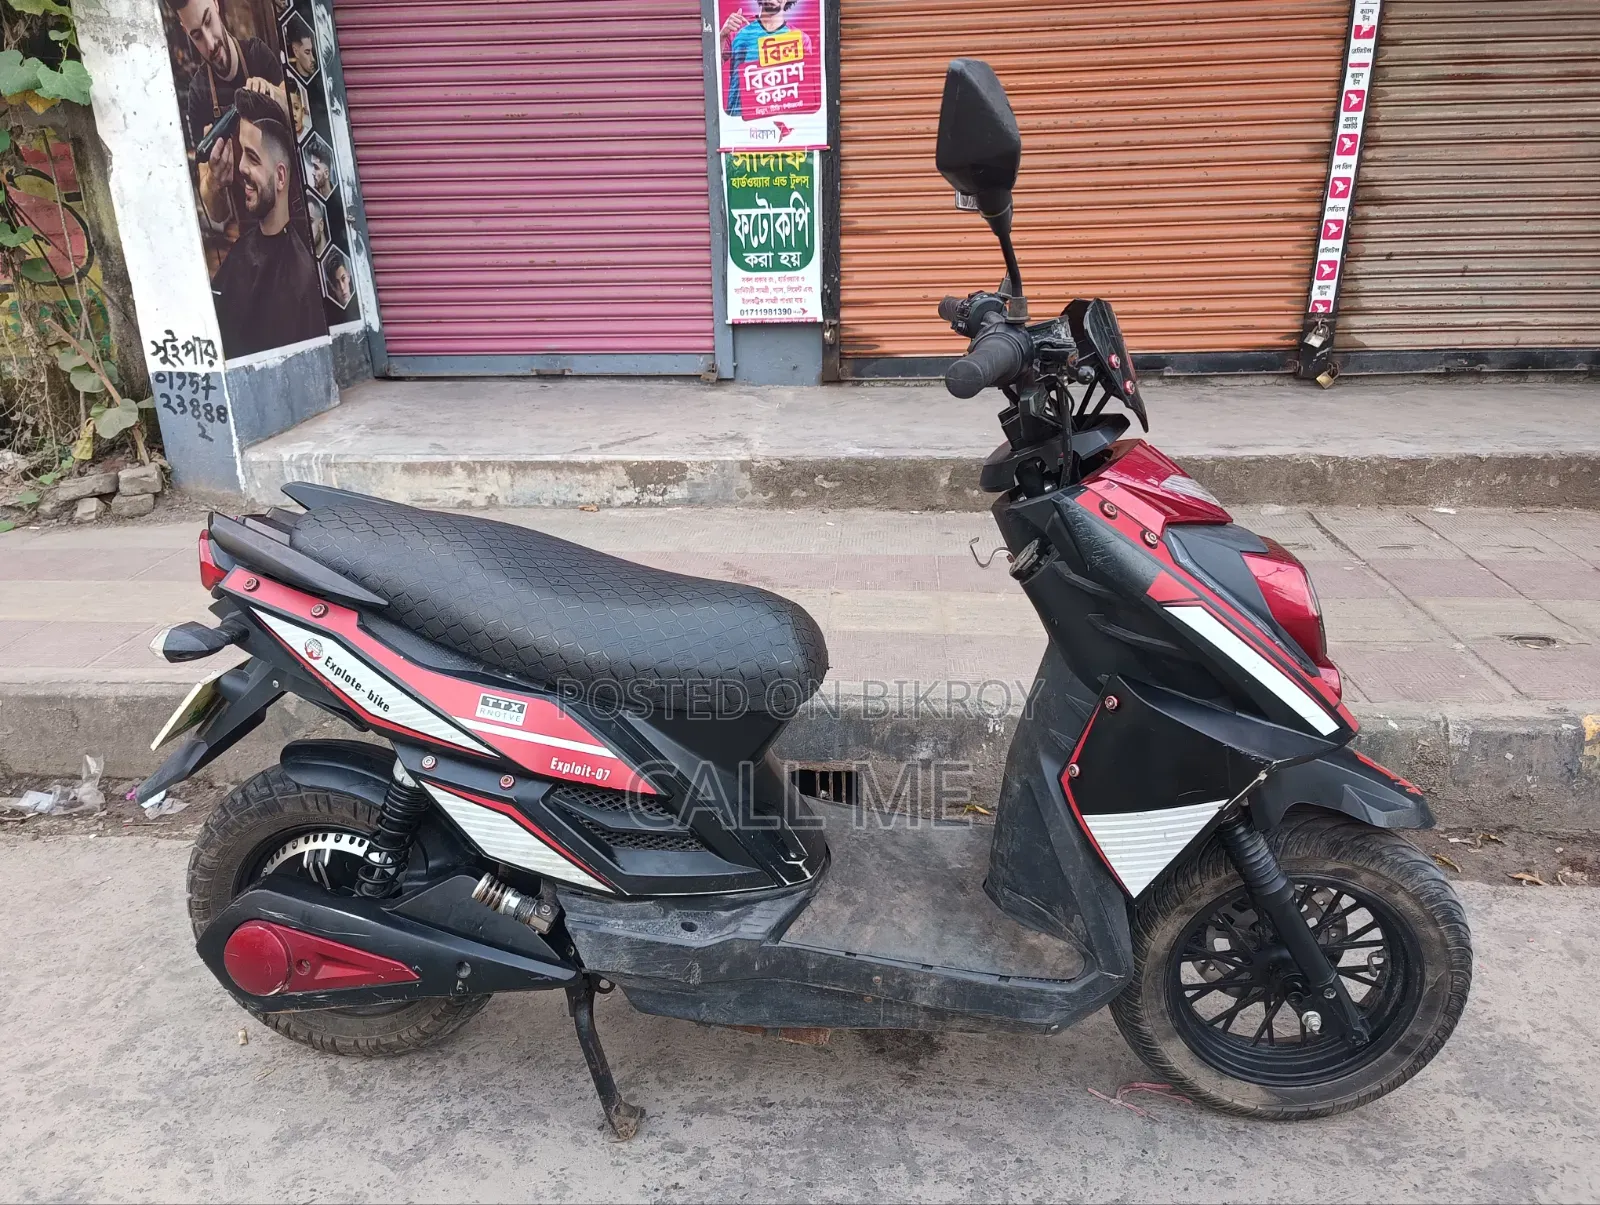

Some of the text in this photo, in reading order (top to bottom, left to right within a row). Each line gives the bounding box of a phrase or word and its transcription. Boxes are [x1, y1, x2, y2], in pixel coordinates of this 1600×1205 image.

[762, 38, 799, 64] বিল
[744, 62, 805, 91] বিকাশ
[755, 82, 799, 105] করুন
[750, 127, 776, 140] বিকাশ
[732, 150, 807, 173] সাদাফ
[731, 191, 811, 249] ফটোকপি
[743, 252, 802, 269] করা হয়
[739, 308, 792, 317] 01711981390
[150, 329, 218, 368] সুইপার
[485, 697, 522, 713] TTX
[550, 757, 611, 781] Exploit-07
